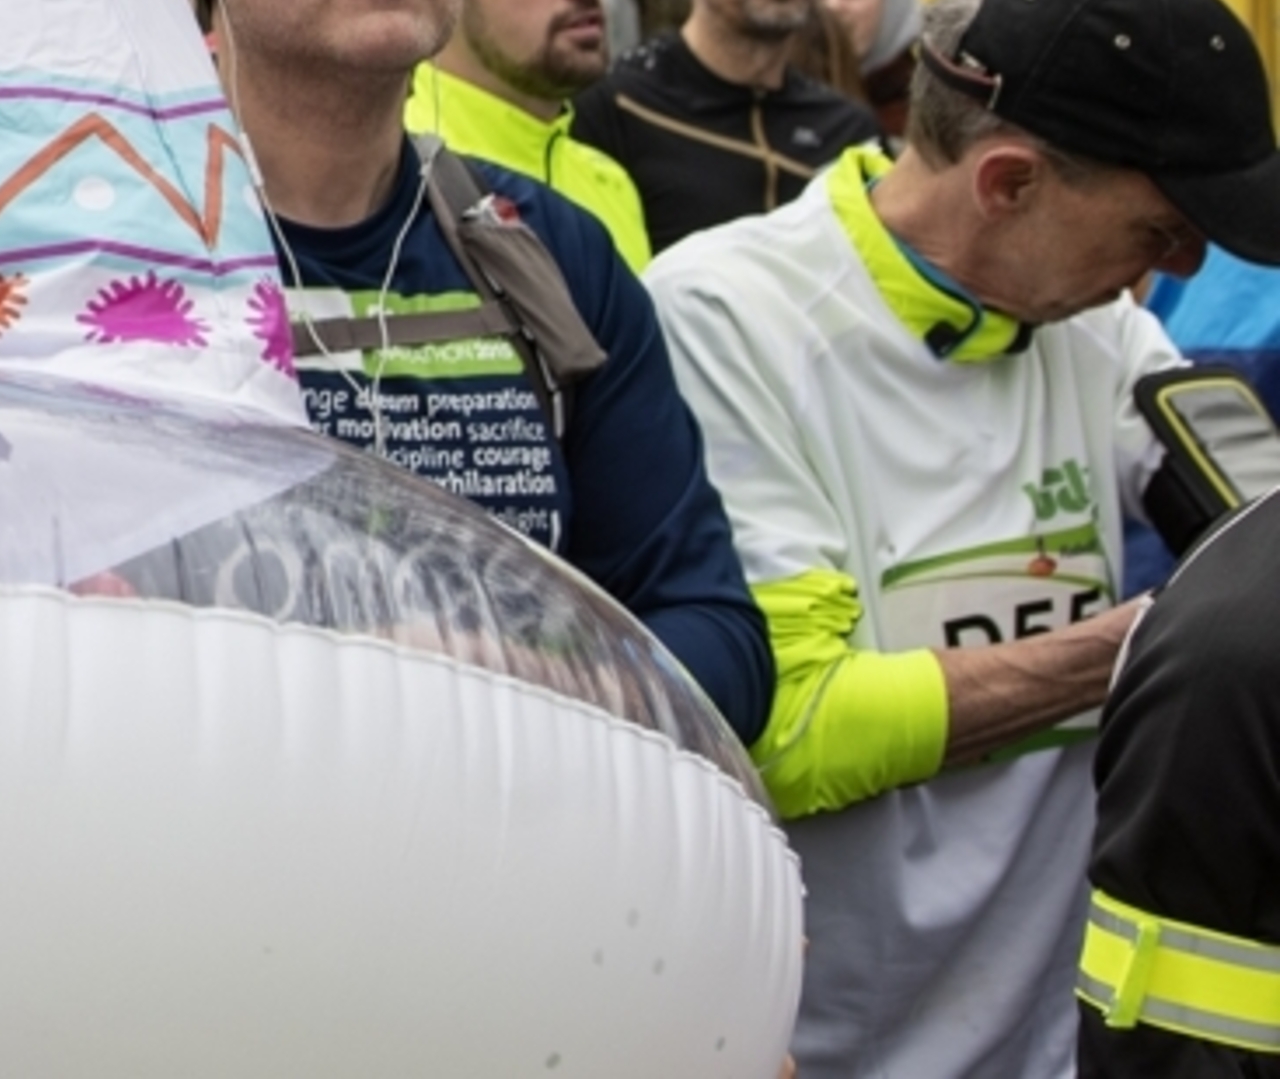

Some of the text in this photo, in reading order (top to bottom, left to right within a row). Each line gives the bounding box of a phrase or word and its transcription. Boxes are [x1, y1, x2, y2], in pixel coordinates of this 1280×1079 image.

[427, 387, 539, 419] preparation
[337, 417, 462, 440] moivation
[466, 416, 547, 441] sacrifice
[364, 445, 551, 473] cipline courage
[424, 470, 555, 495] hilaration
[486, 506, 548, 532] elight
